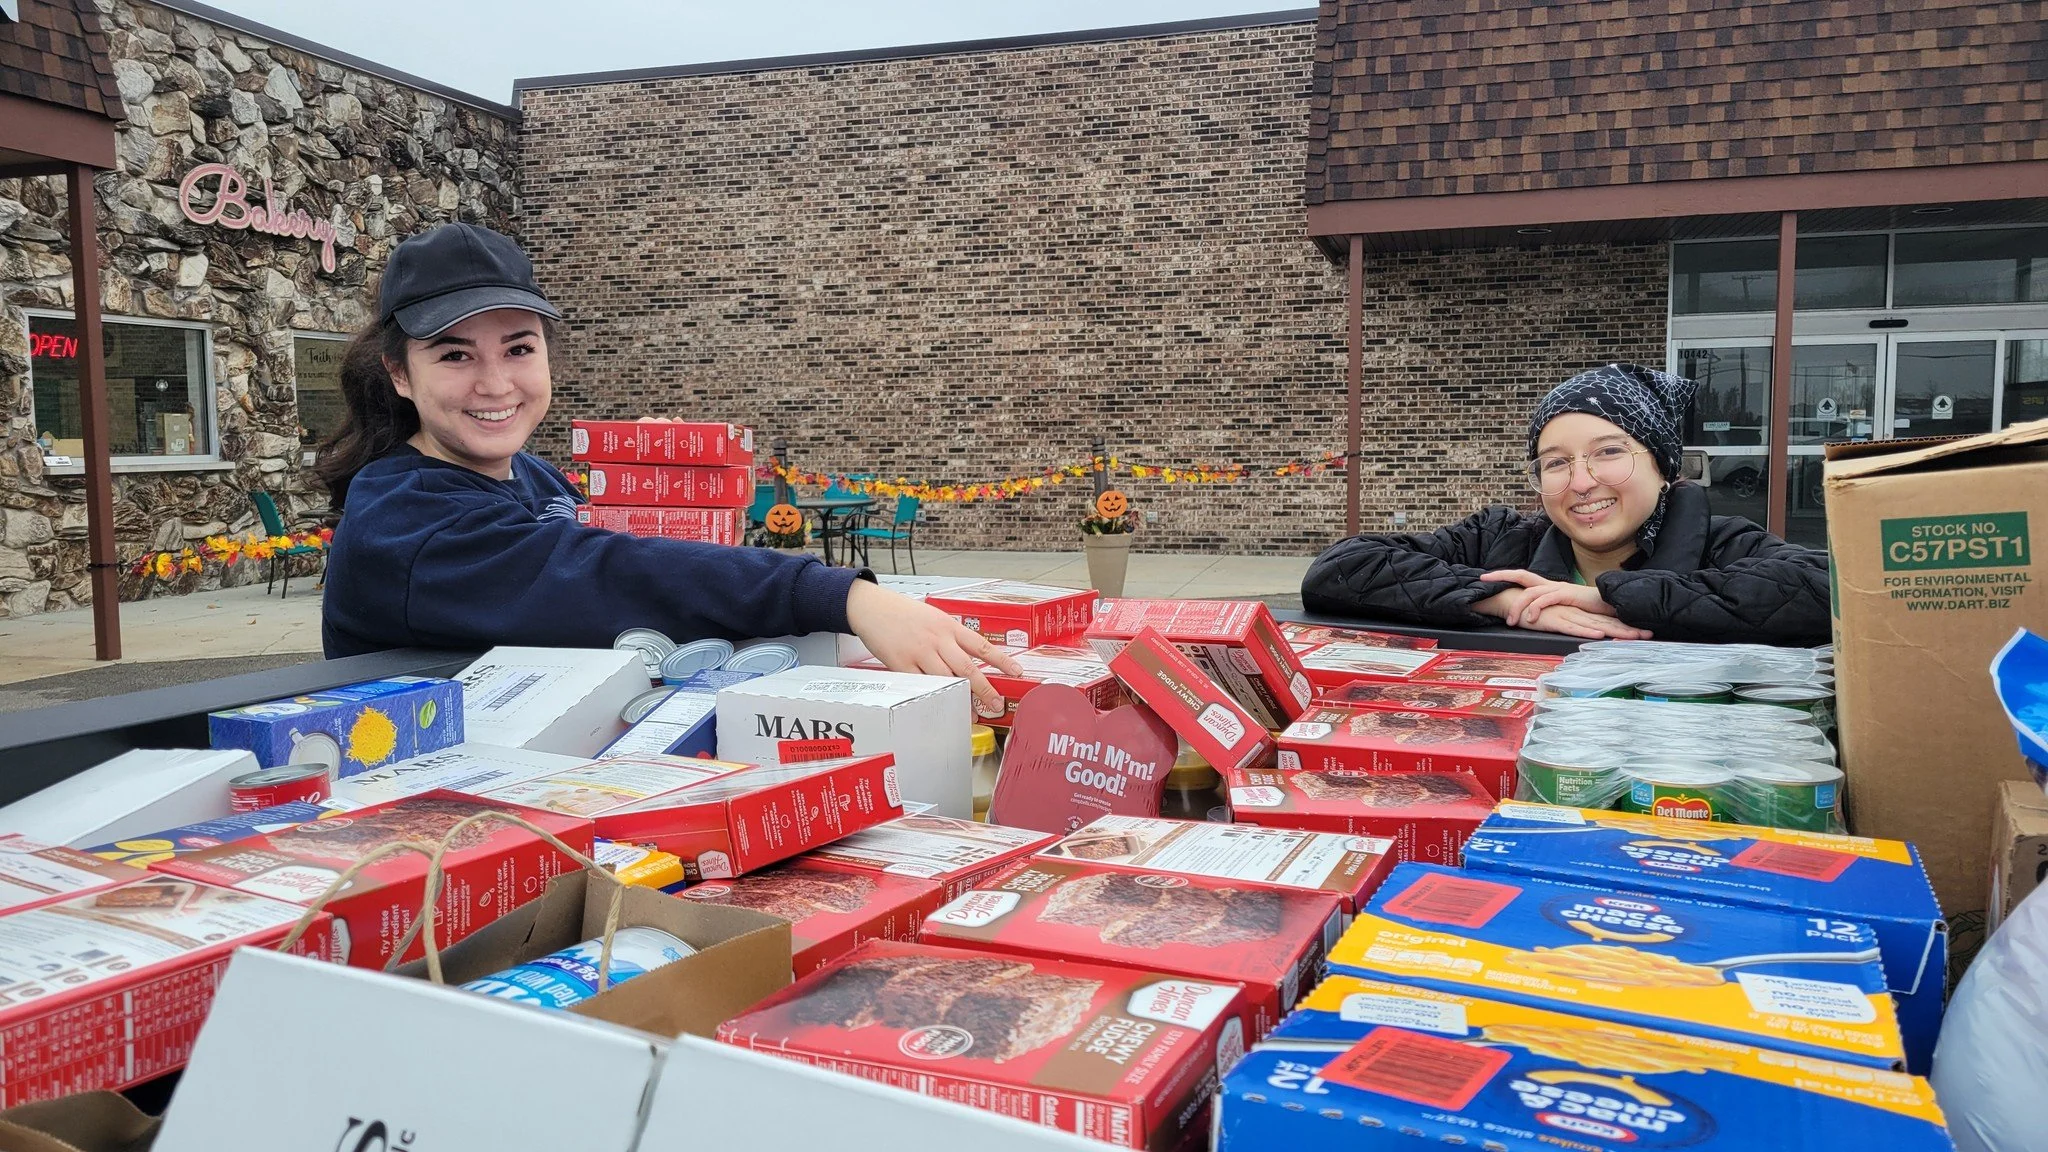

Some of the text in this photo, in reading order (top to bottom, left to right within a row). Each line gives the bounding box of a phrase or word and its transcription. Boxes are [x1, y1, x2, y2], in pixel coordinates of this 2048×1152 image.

[179, 163, 337, 273] Bakery
[29, 334, 78, 359] OPEN
[1912, 522, 2000, 538] STOCK NO.
[1890, 536, 2023, 563] C57PST1
[1884, 573, 2032, 587] FOR ENVIRONMENTAL
[1891, 585, 2025, 599] INFORMATION, VISIT
[1907, 599, 2010, 611] WWW.DART.BIZ
[1157, 670, 1200, 712] CHEWY FUDGE
[755, 713, 855, 747] MARS
[1204, 714, 1236, 743] Duncan
[354, 752, 464, 786] MARS
[1065, 761, 1127, 797] Good!
[890, 768, 901, 802] Duncan
[1559, 777, 1592, 785] Nutrition
[1559, 784, 1580, 792] Facts
[858, 778, 870, 814] ingredient
[866, 792, 874, 812] these
[1656, 806, 1708, 819] Del Monte
[1470, 843, 1510, 854] 12
[1652, 854, 1719, 868] mac
[1002, 869, 1041, 890] CHEWY
[1016, 874, 1055, 891] FUDGE
[1684, 876, 1746, 888] cheesiest
[1555, 881, 1613, 893] cheesiest
[1616, 890, 1657, 899] smiles
[1659, 894, 1691, 904] since
[946, 892, 988, 920] Duncan
[1574, 903, 1677, 925] mac &
[1608, 900, 1646, 910] Kraft
[1807, 918, 1858, 934] 12
[1378, 930, 1468, 948] original
[1806, 929, 1864, 944] pack
[380, 938, 390, 956] Try
[578, 965, 599, 981] 8g
[1772, 990, 1852, 1004] no artificial
[1790, 982, 1844, 992] artificial
[1171, 985, 1212, 1022] Duncan
[1772, 996, 1860, 1008] preservatives
[1807, 1008, 1862, 1018] artificial
[1076, 1015, 1112, 1044] BROWNIE
[1086, 1018, 1128, 1055] FUDGE
[1105, 1022, 1156, 1065] CHEWY
[1144, 1044, 1170, 1072] FAMILY
[1124, 1064, 1148, 1086] SIZE
[1267, 1068, 1330, 1095] 12
[1518, 1092, 1668, 1132] mac &
[1111, 1107, 1129, 1149] Nutri
[1482, 1122, 1534, 1140] since
[1560, 1118, 1614, 1136] Kraft
